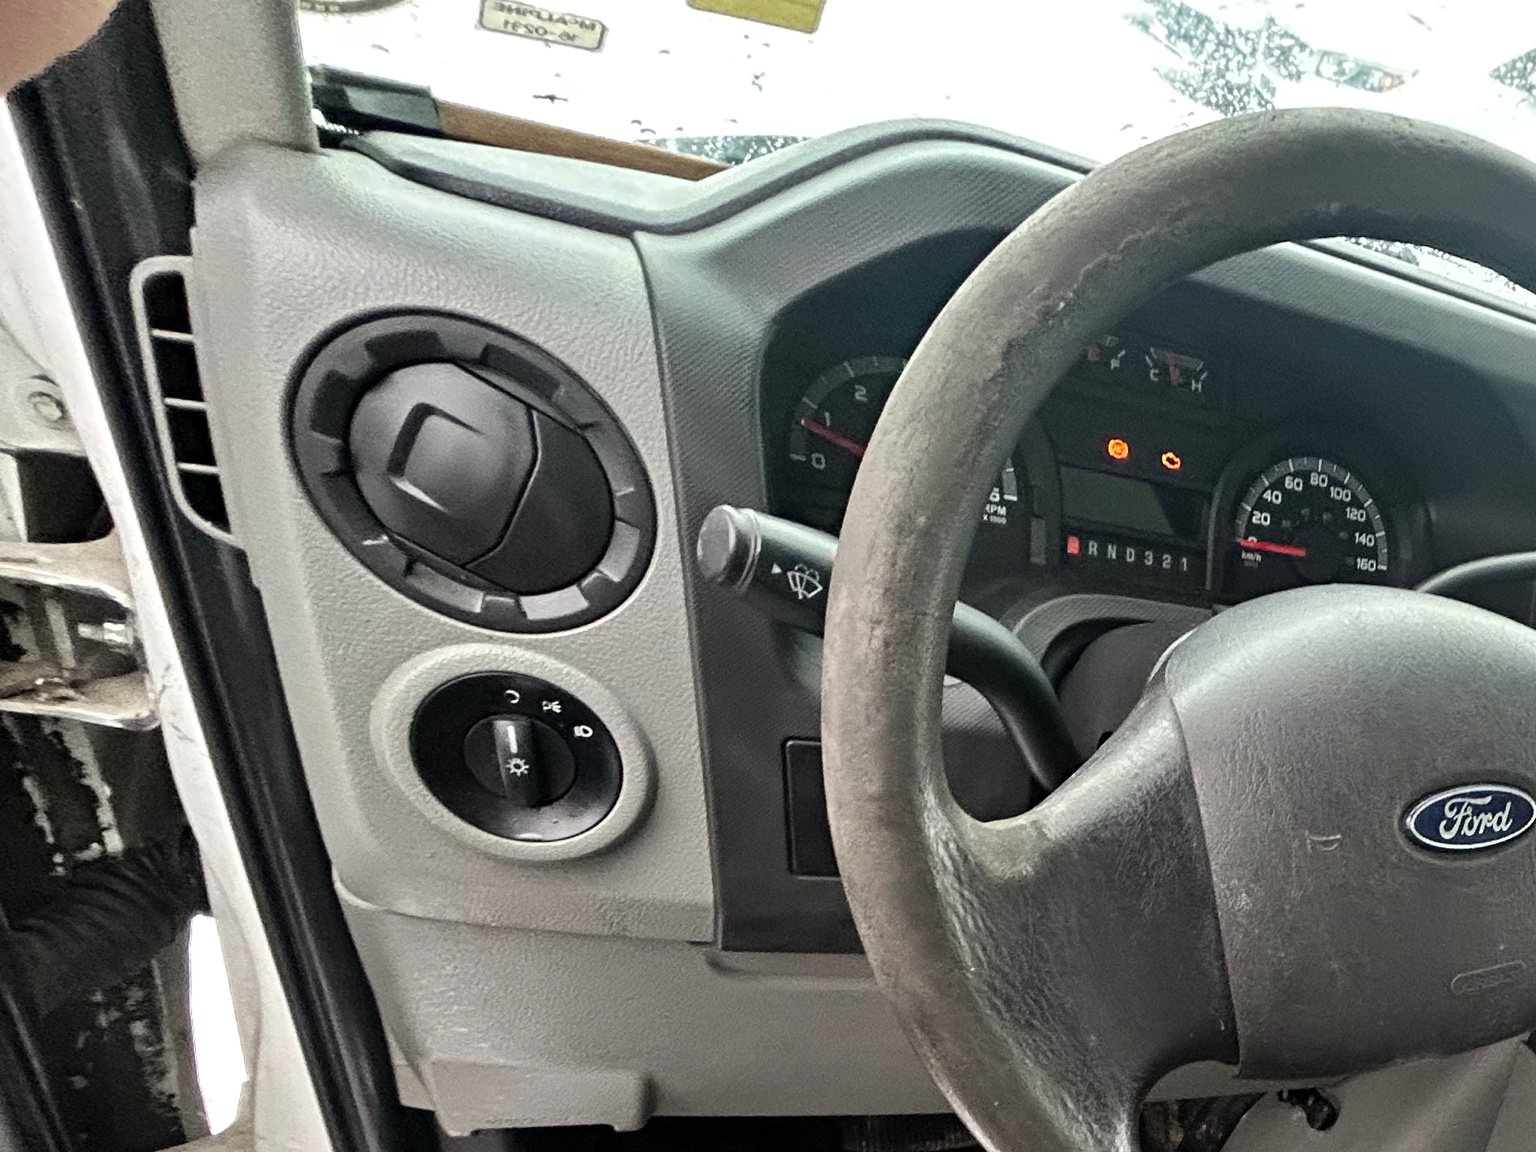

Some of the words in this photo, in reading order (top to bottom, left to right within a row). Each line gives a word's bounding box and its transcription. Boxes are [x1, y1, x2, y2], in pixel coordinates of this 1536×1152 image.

[854, 384, 868, 402] 2
[1191, 379, 1202, 392] H
[811, 453, 825, 470] 0
[1284, 475, 1303, 492] 60
[1309, 472, 1328, 488] 80
[1262, 489, 1282, 505] 40
[1329, 486, 1352, 502] 100
[1252, 510, 1271, 527] 20
[1345, 506, 1366, 523] 120
[1354, 531, 1375, 548] 140
[1088, 540, 1098, 557] R
[1107, 543, 1117, 560] N
[1126, 547, 1135, 562] D
[1144, 551, 1154, 566] 3
[1162, 554, 1172, 569] 2
[1356, 557, 1377, 572] 160
[1439, 795, 1513, 840] Ford
